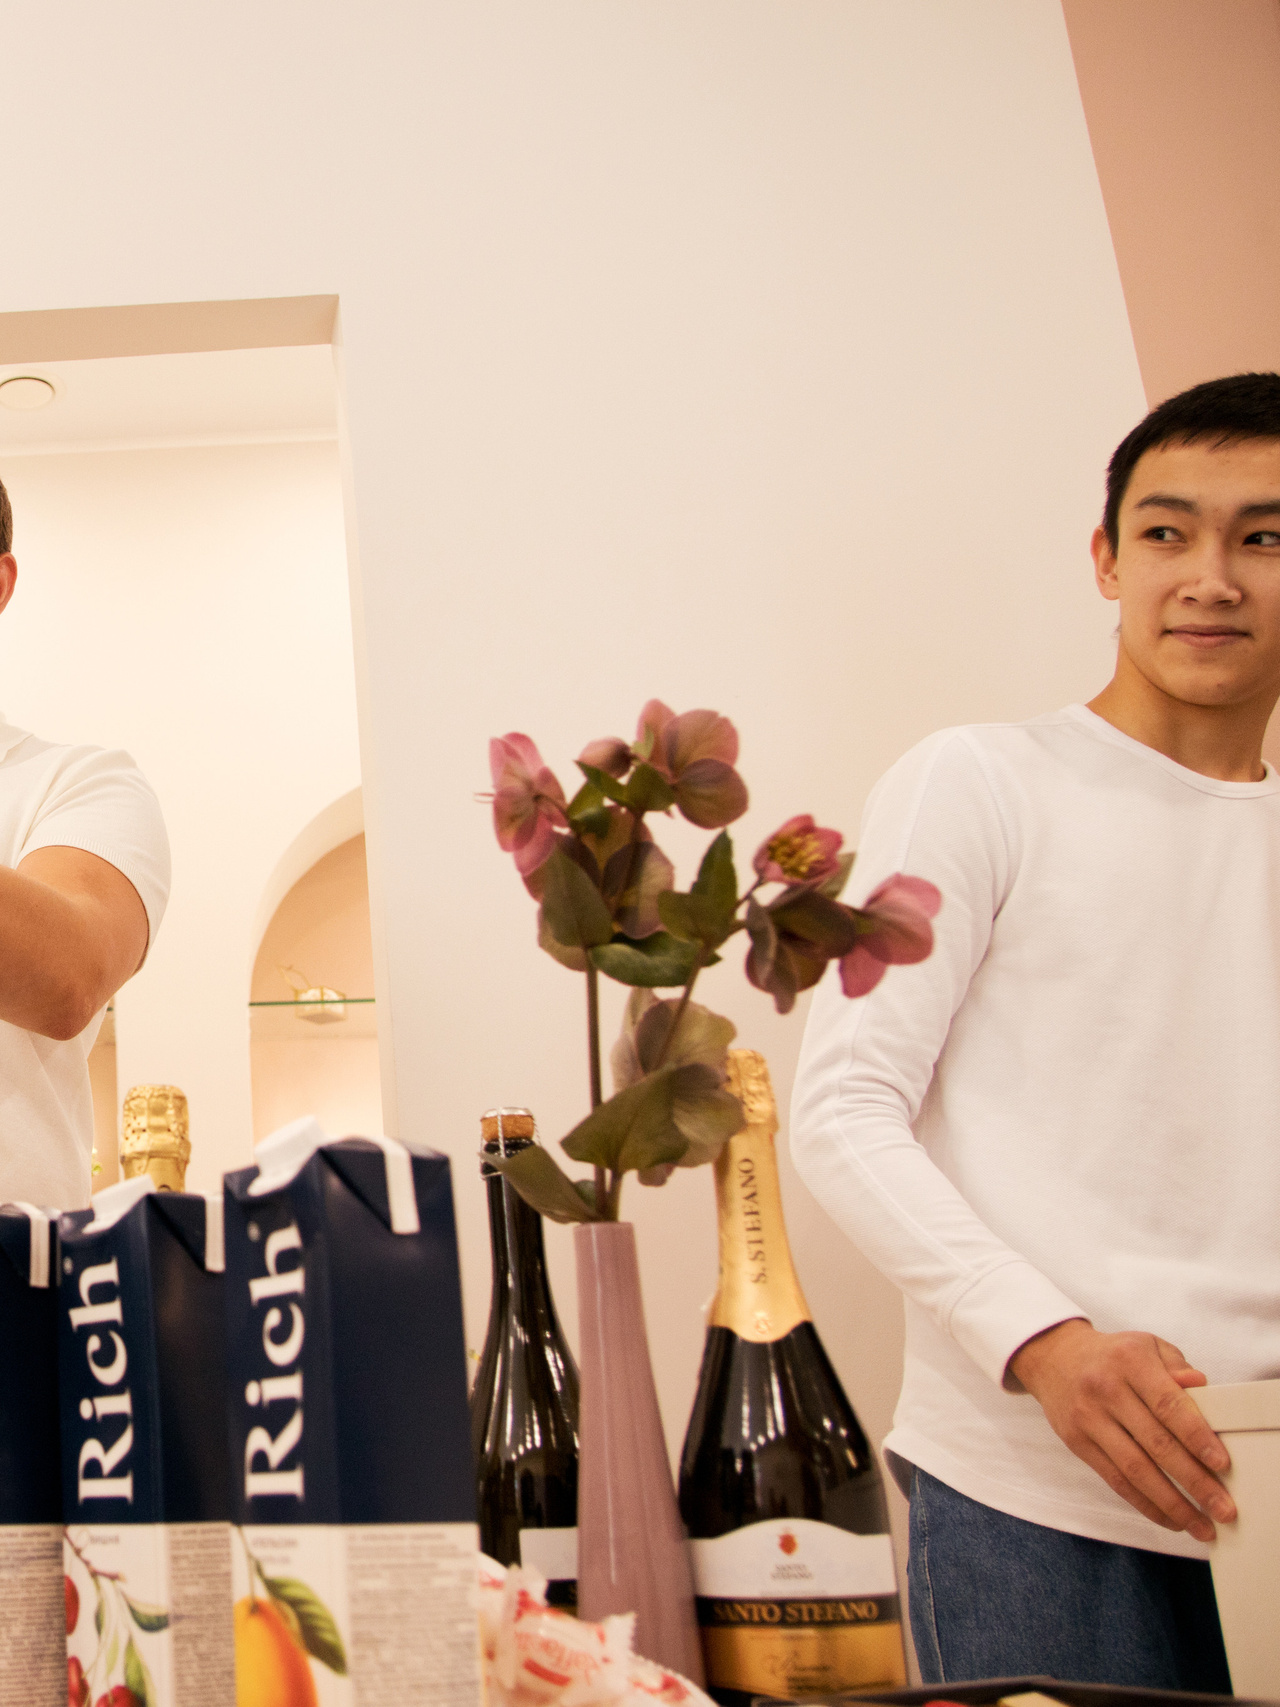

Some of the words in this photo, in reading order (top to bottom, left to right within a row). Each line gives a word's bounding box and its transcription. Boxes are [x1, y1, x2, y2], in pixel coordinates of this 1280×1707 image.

[737, 1158, 766, 1262] STEFANO
[68, 1256, 134, 1504] Rich
[245, 1224, 306, 1502] Rich
[784, 1601, 880, 1624] STEFANO
